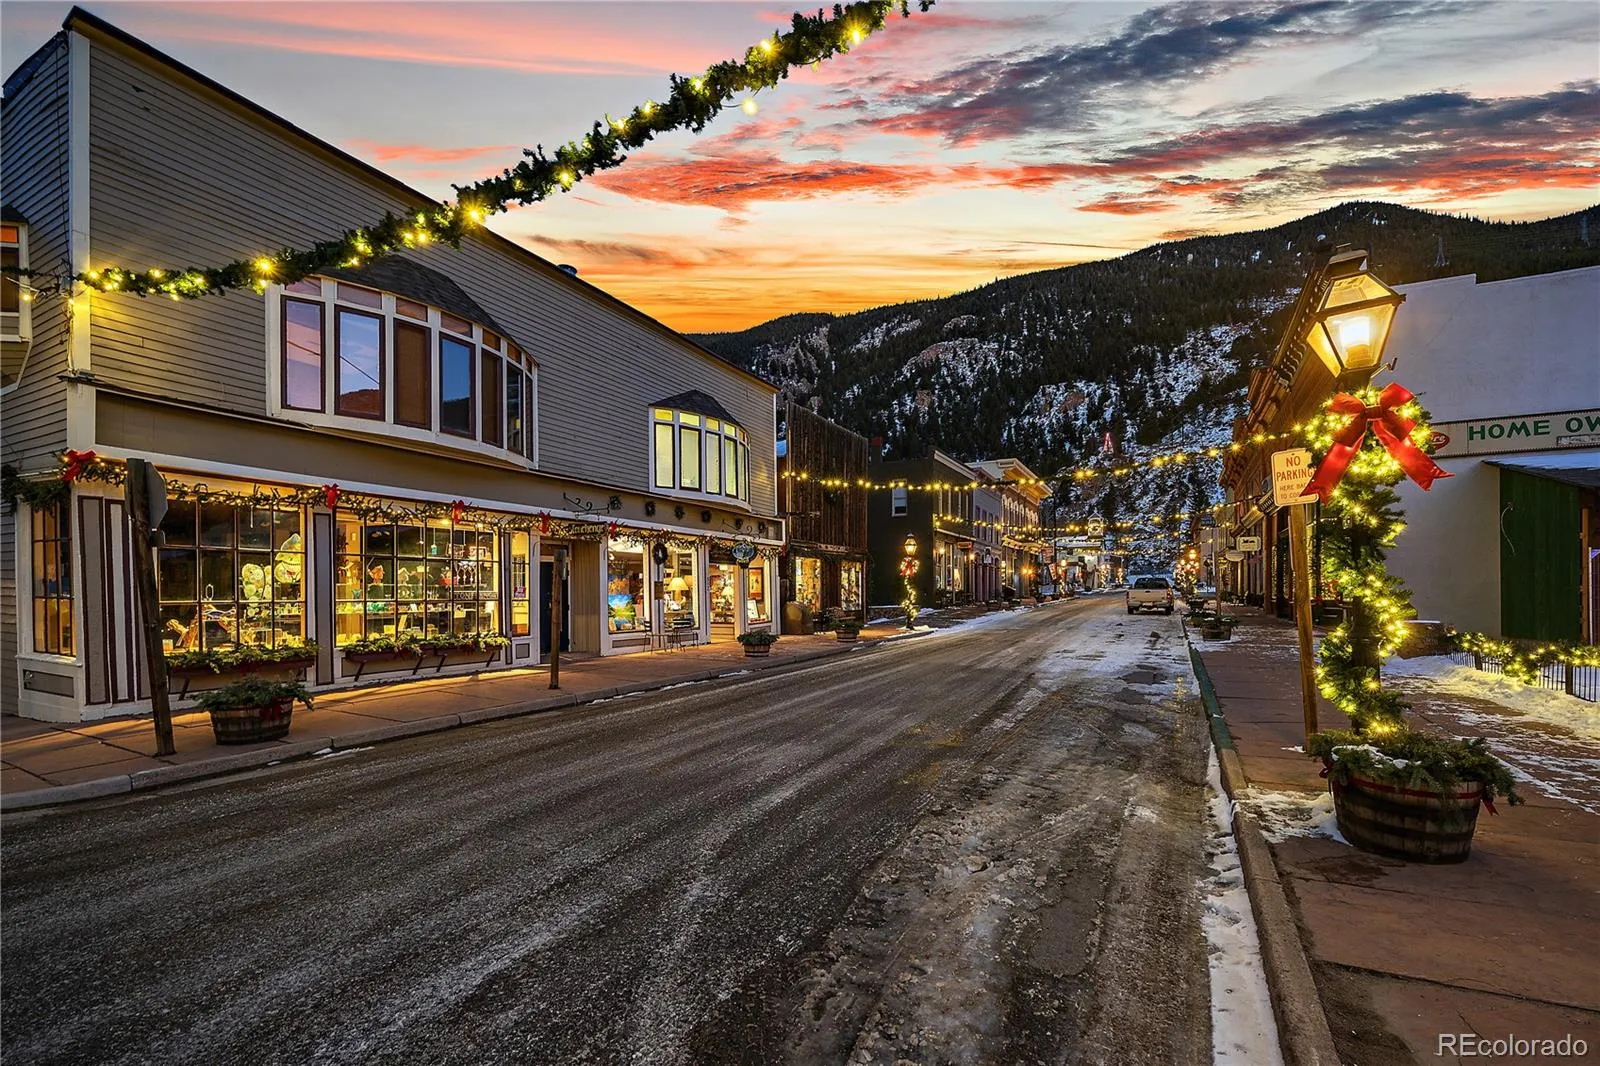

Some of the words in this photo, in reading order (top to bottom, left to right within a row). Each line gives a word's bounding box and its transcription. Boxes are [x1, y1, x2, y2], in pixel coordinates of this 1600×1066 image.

[1469, 420, 1550, 441] HOME
[1286, 456, 1301, 467] NO
[1276, 468, 1313, 482] PARKING
